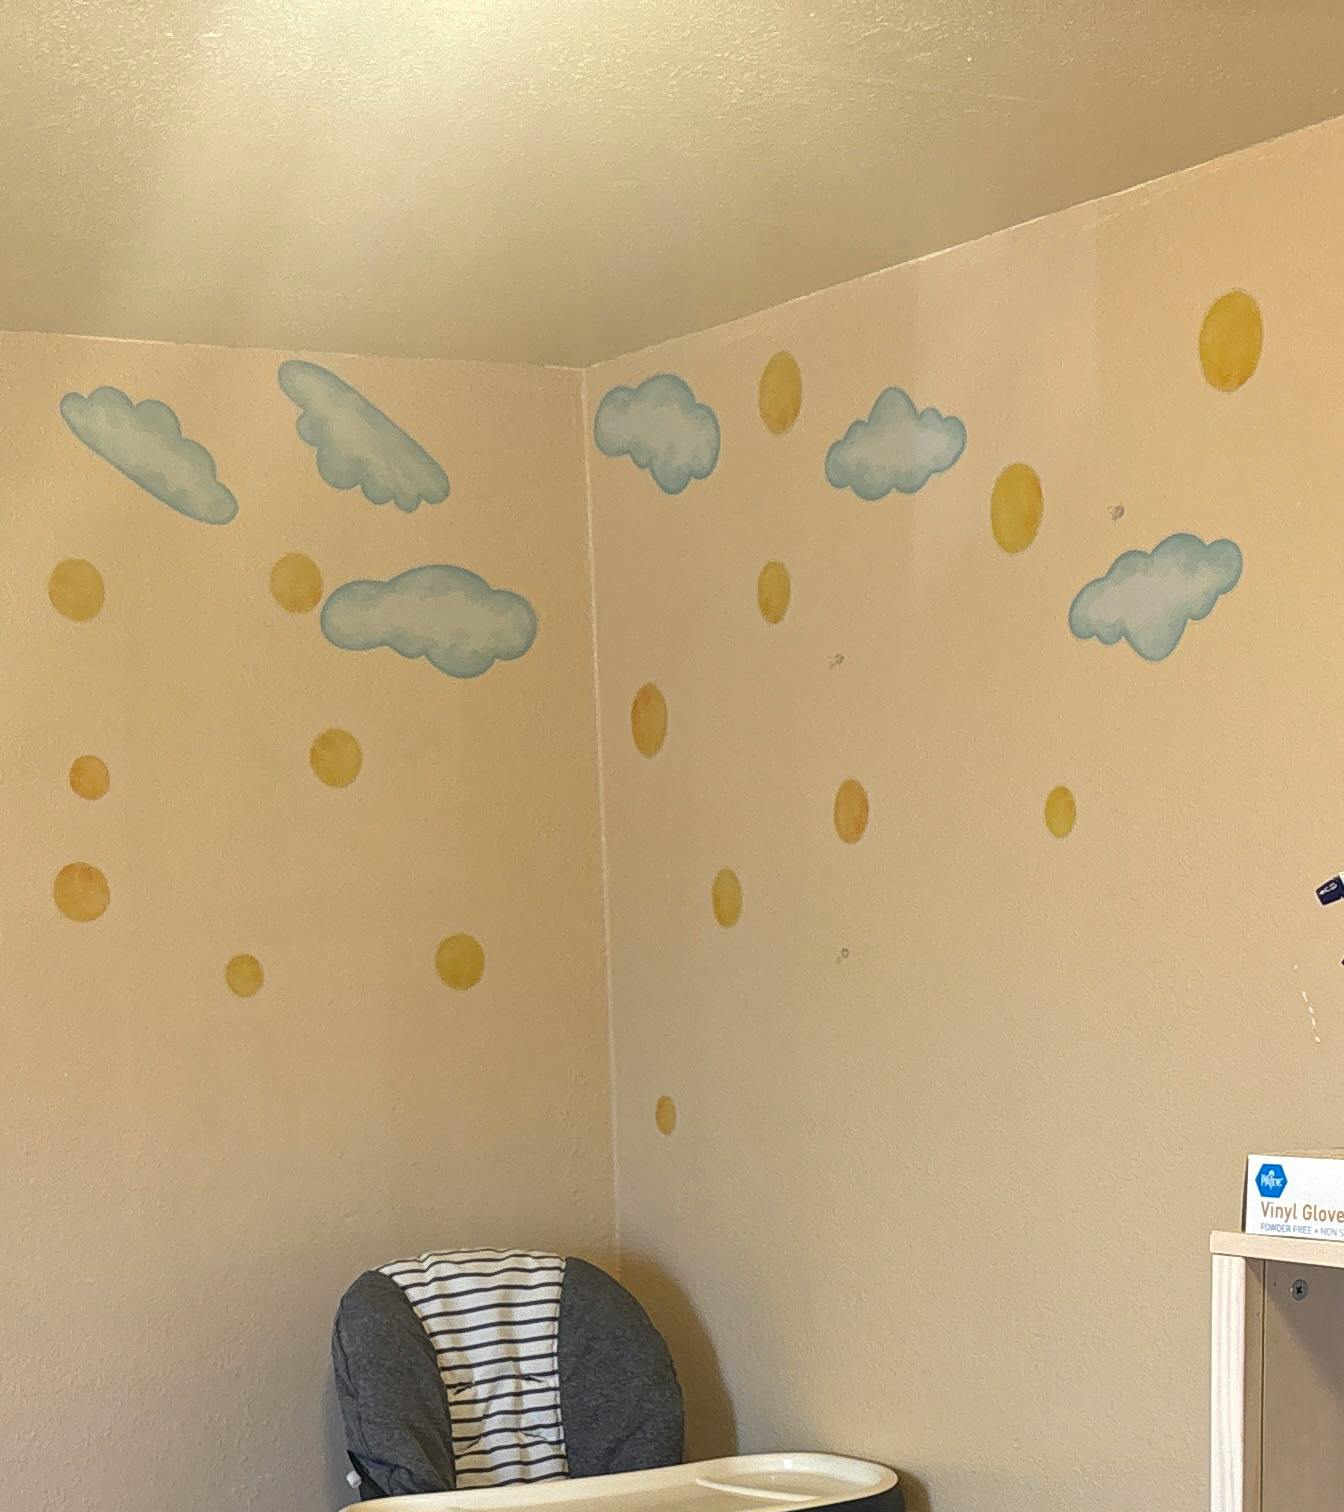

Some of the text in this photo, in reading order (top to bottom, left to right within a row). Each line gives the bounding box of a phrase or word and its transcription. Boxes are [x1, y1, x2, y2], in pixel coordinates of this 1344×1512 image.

[1261, 1200, 1297, 1223] Vinyl
[1260, 1222, 1291, 1233] POWDER
[1292, 1224, 1312, 1234] FREE
